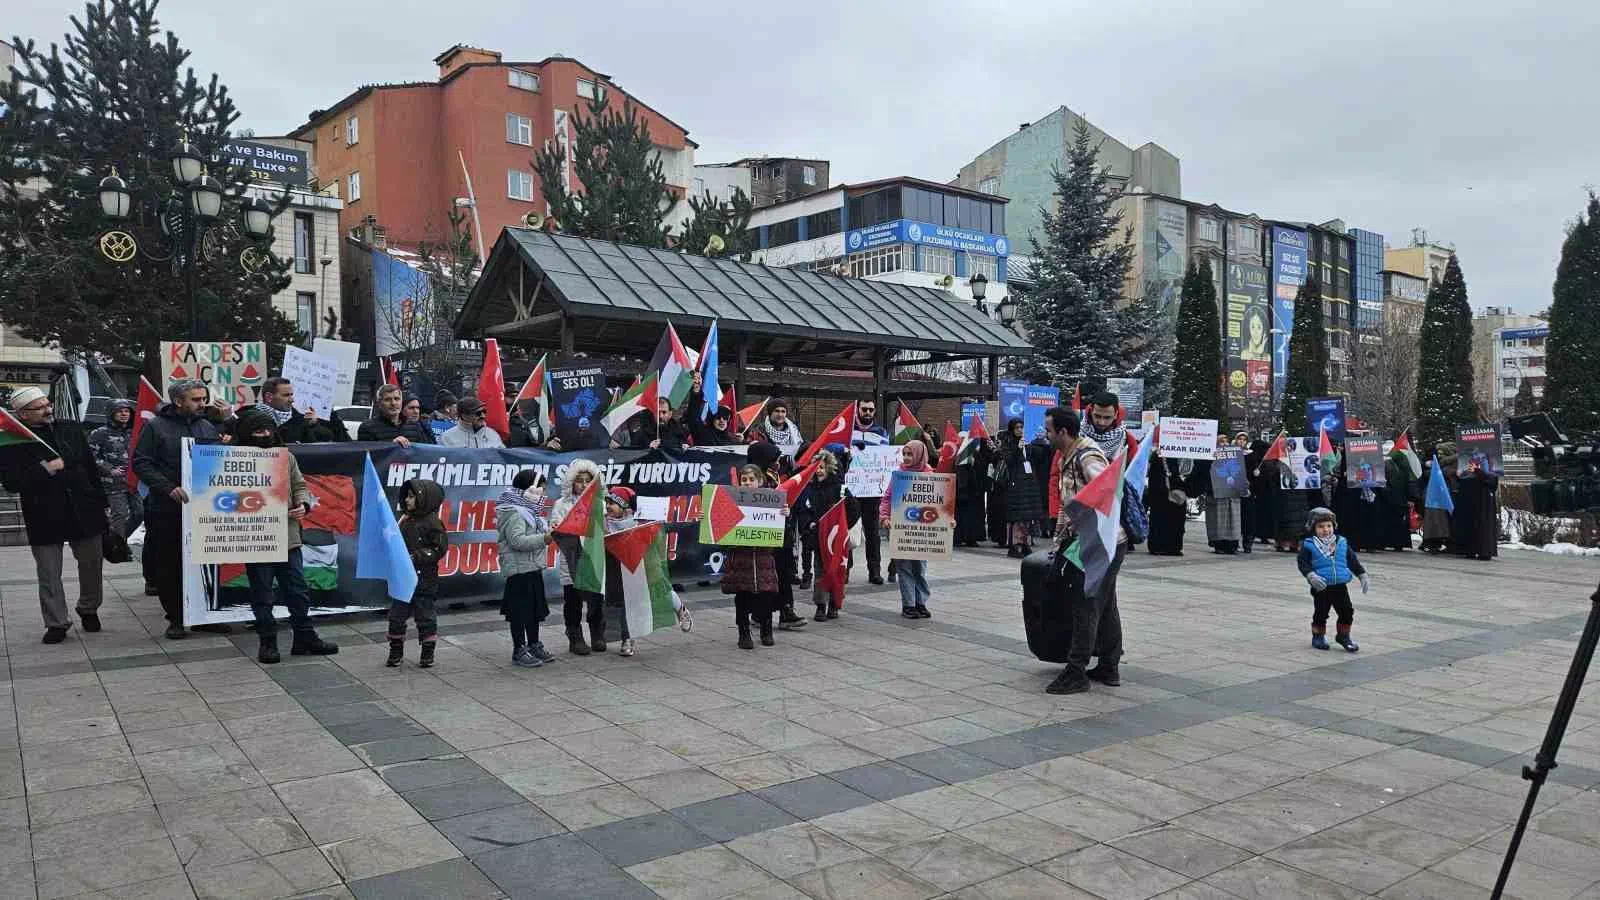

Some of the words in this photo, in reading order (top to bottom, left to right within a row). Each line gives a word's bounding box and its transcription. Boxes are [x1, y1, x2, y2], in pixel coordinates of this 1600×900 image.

[253, 159, 287, 172] Luxe
[563, 378, 579, 390] SES
[580, 375, 594, 388] OL!
[224, 459, 257, 472] EBEDİ
[208, 473, 272, 488] KARDEŞLİK
[912, 482, 935, 493] EBEDİ
[751, 492, 780, 503] STAND
[902, 493, 944, 504] KARDEŞLİK
[752, 512, 776, 521] WITH
